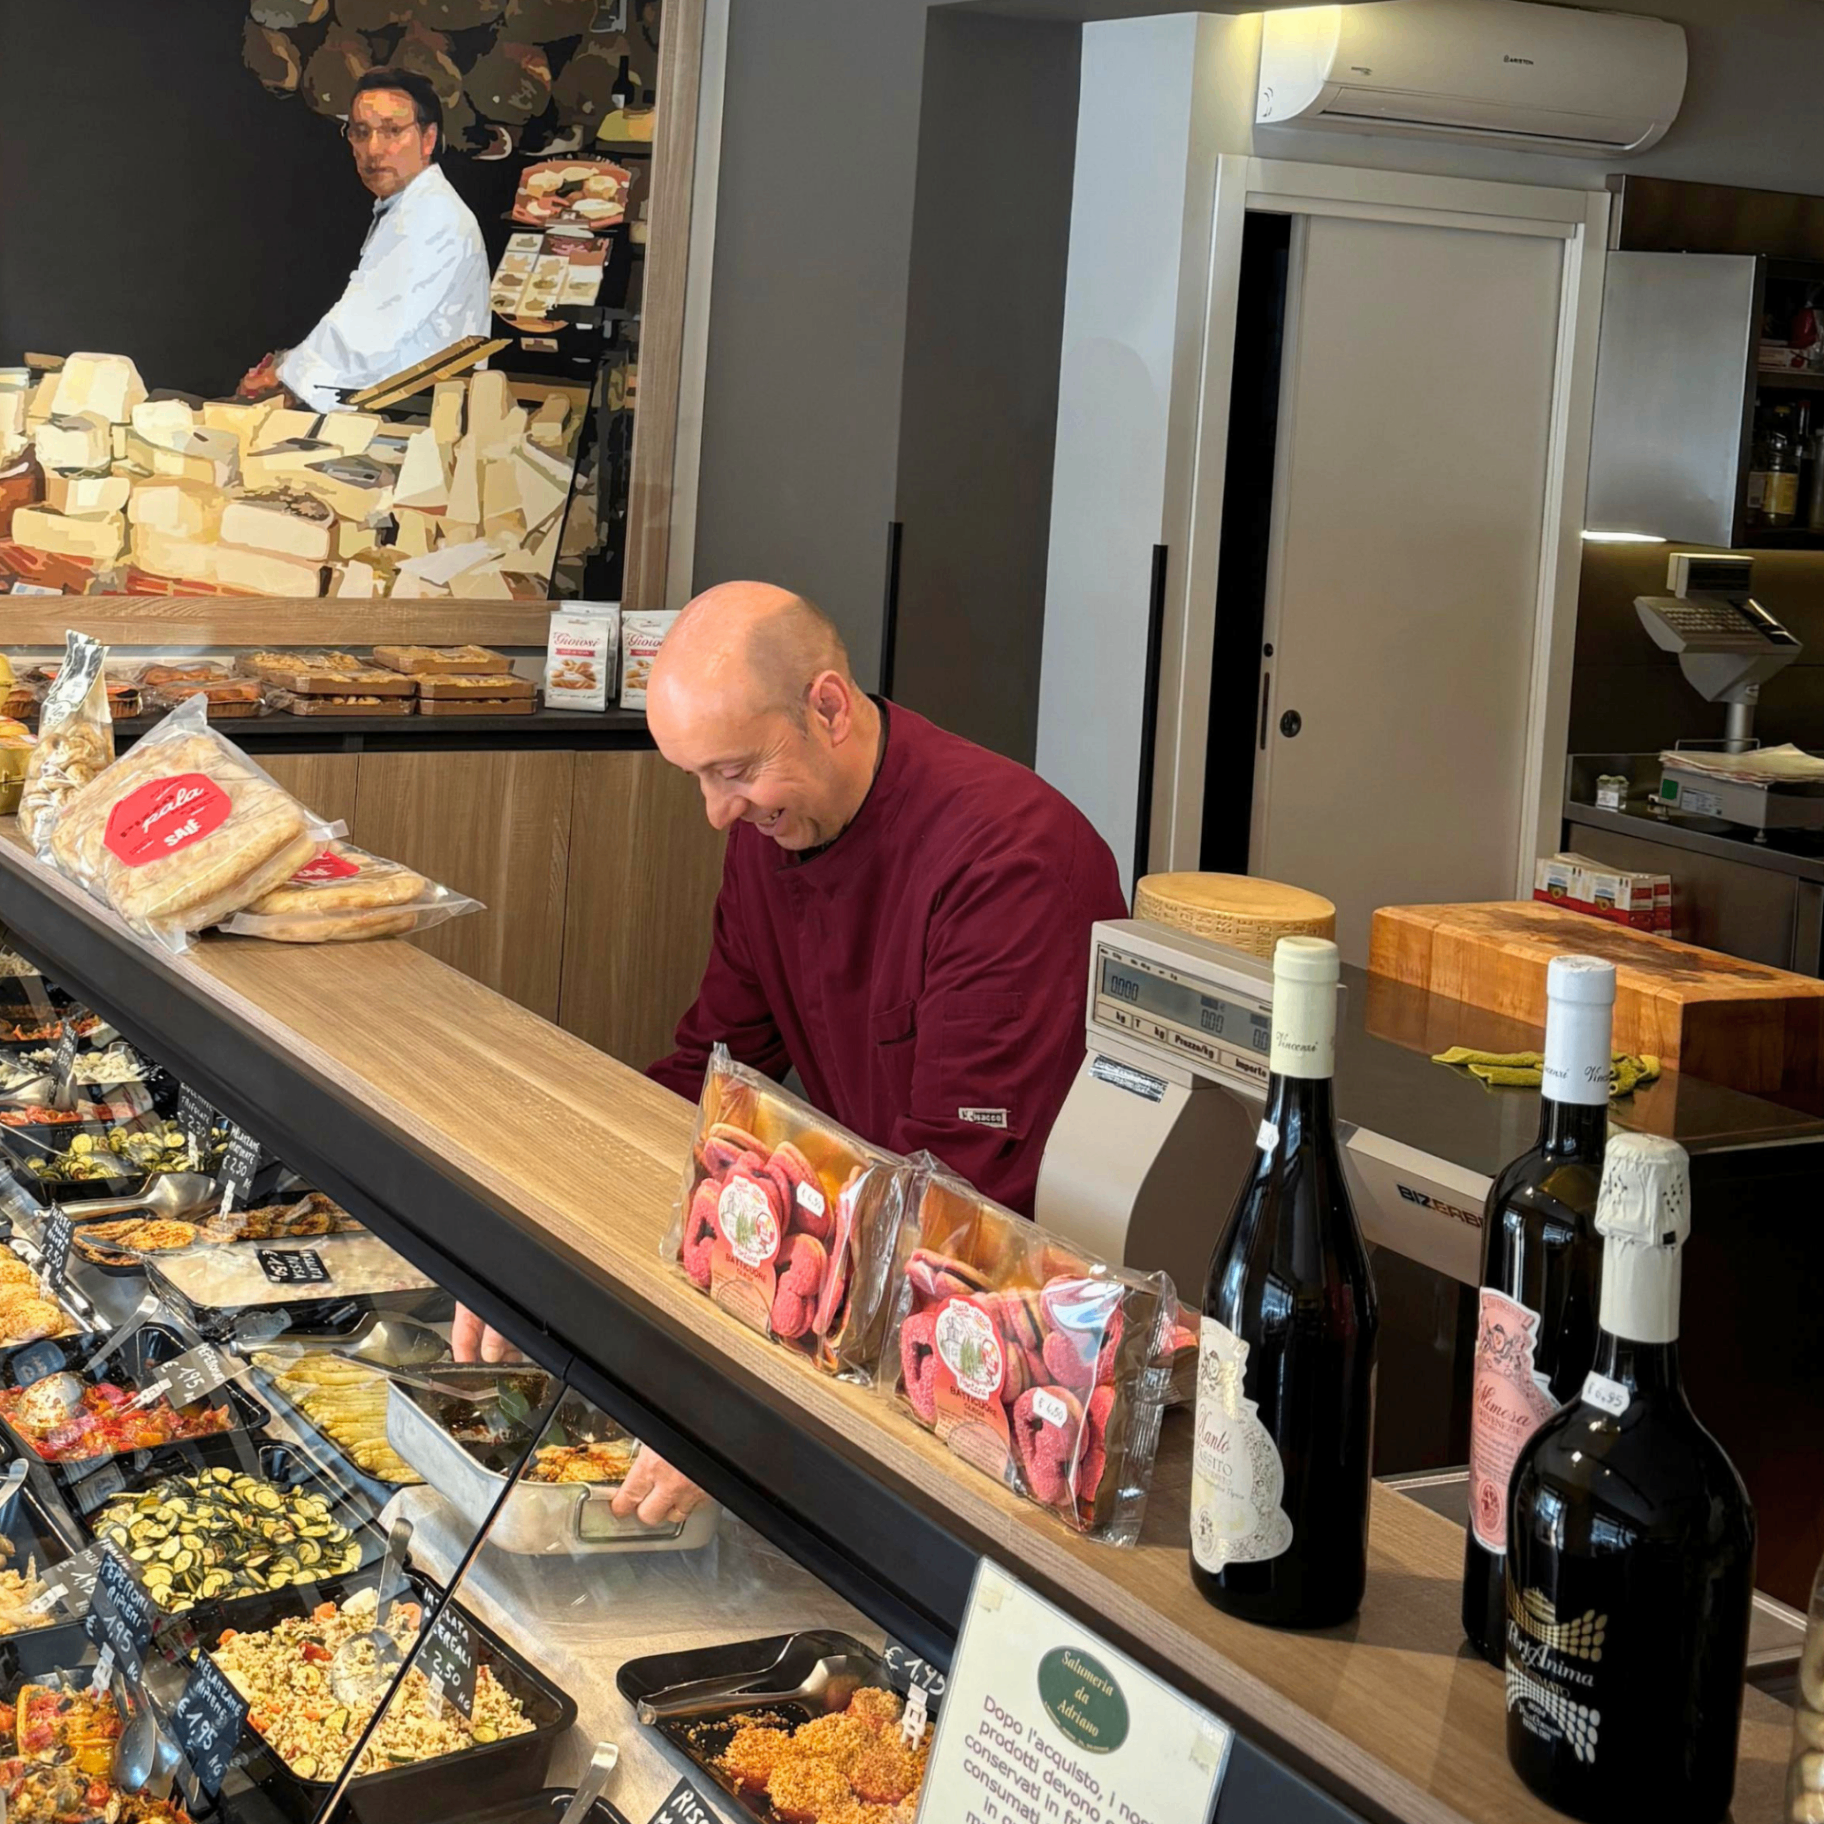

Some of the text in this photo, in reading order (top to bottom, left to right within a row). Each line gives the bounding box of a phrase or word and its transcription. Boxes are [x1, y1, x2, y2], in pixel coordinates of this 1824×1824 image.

[164, 818, 201, 847] SALE
[1115, 1010, 1126, 1024] kg
[1135, 1018, 1166, 1040] T kg
[1235, 1058, 1268, 1079] Importo
[103, 1615, 134, 1653] 1,95
[432, 1650, 462, 1687] 2,50
[884, 1645, 904, 1670] €
[1061, 1650, 1114, 1697] Salumeria
[1074, 1686, 1090, 1705] da
[177, 1697, 219, 1751] € 1,95
[1057, 1699, 1099, 1737] Adriano
[983, 1695, 1023, 1736] Dopo
[1027, 1727, 1104, 1802] l'acquisto,
[964, 1733, 1060, 1818] conservati in
[979, 1720, 1040, 1774] prodotti
[1042, 1769, 1101, 1823] devono
[963, 1757, 1041, 1824] consumati
[983, 1795, 999, 1820] in
